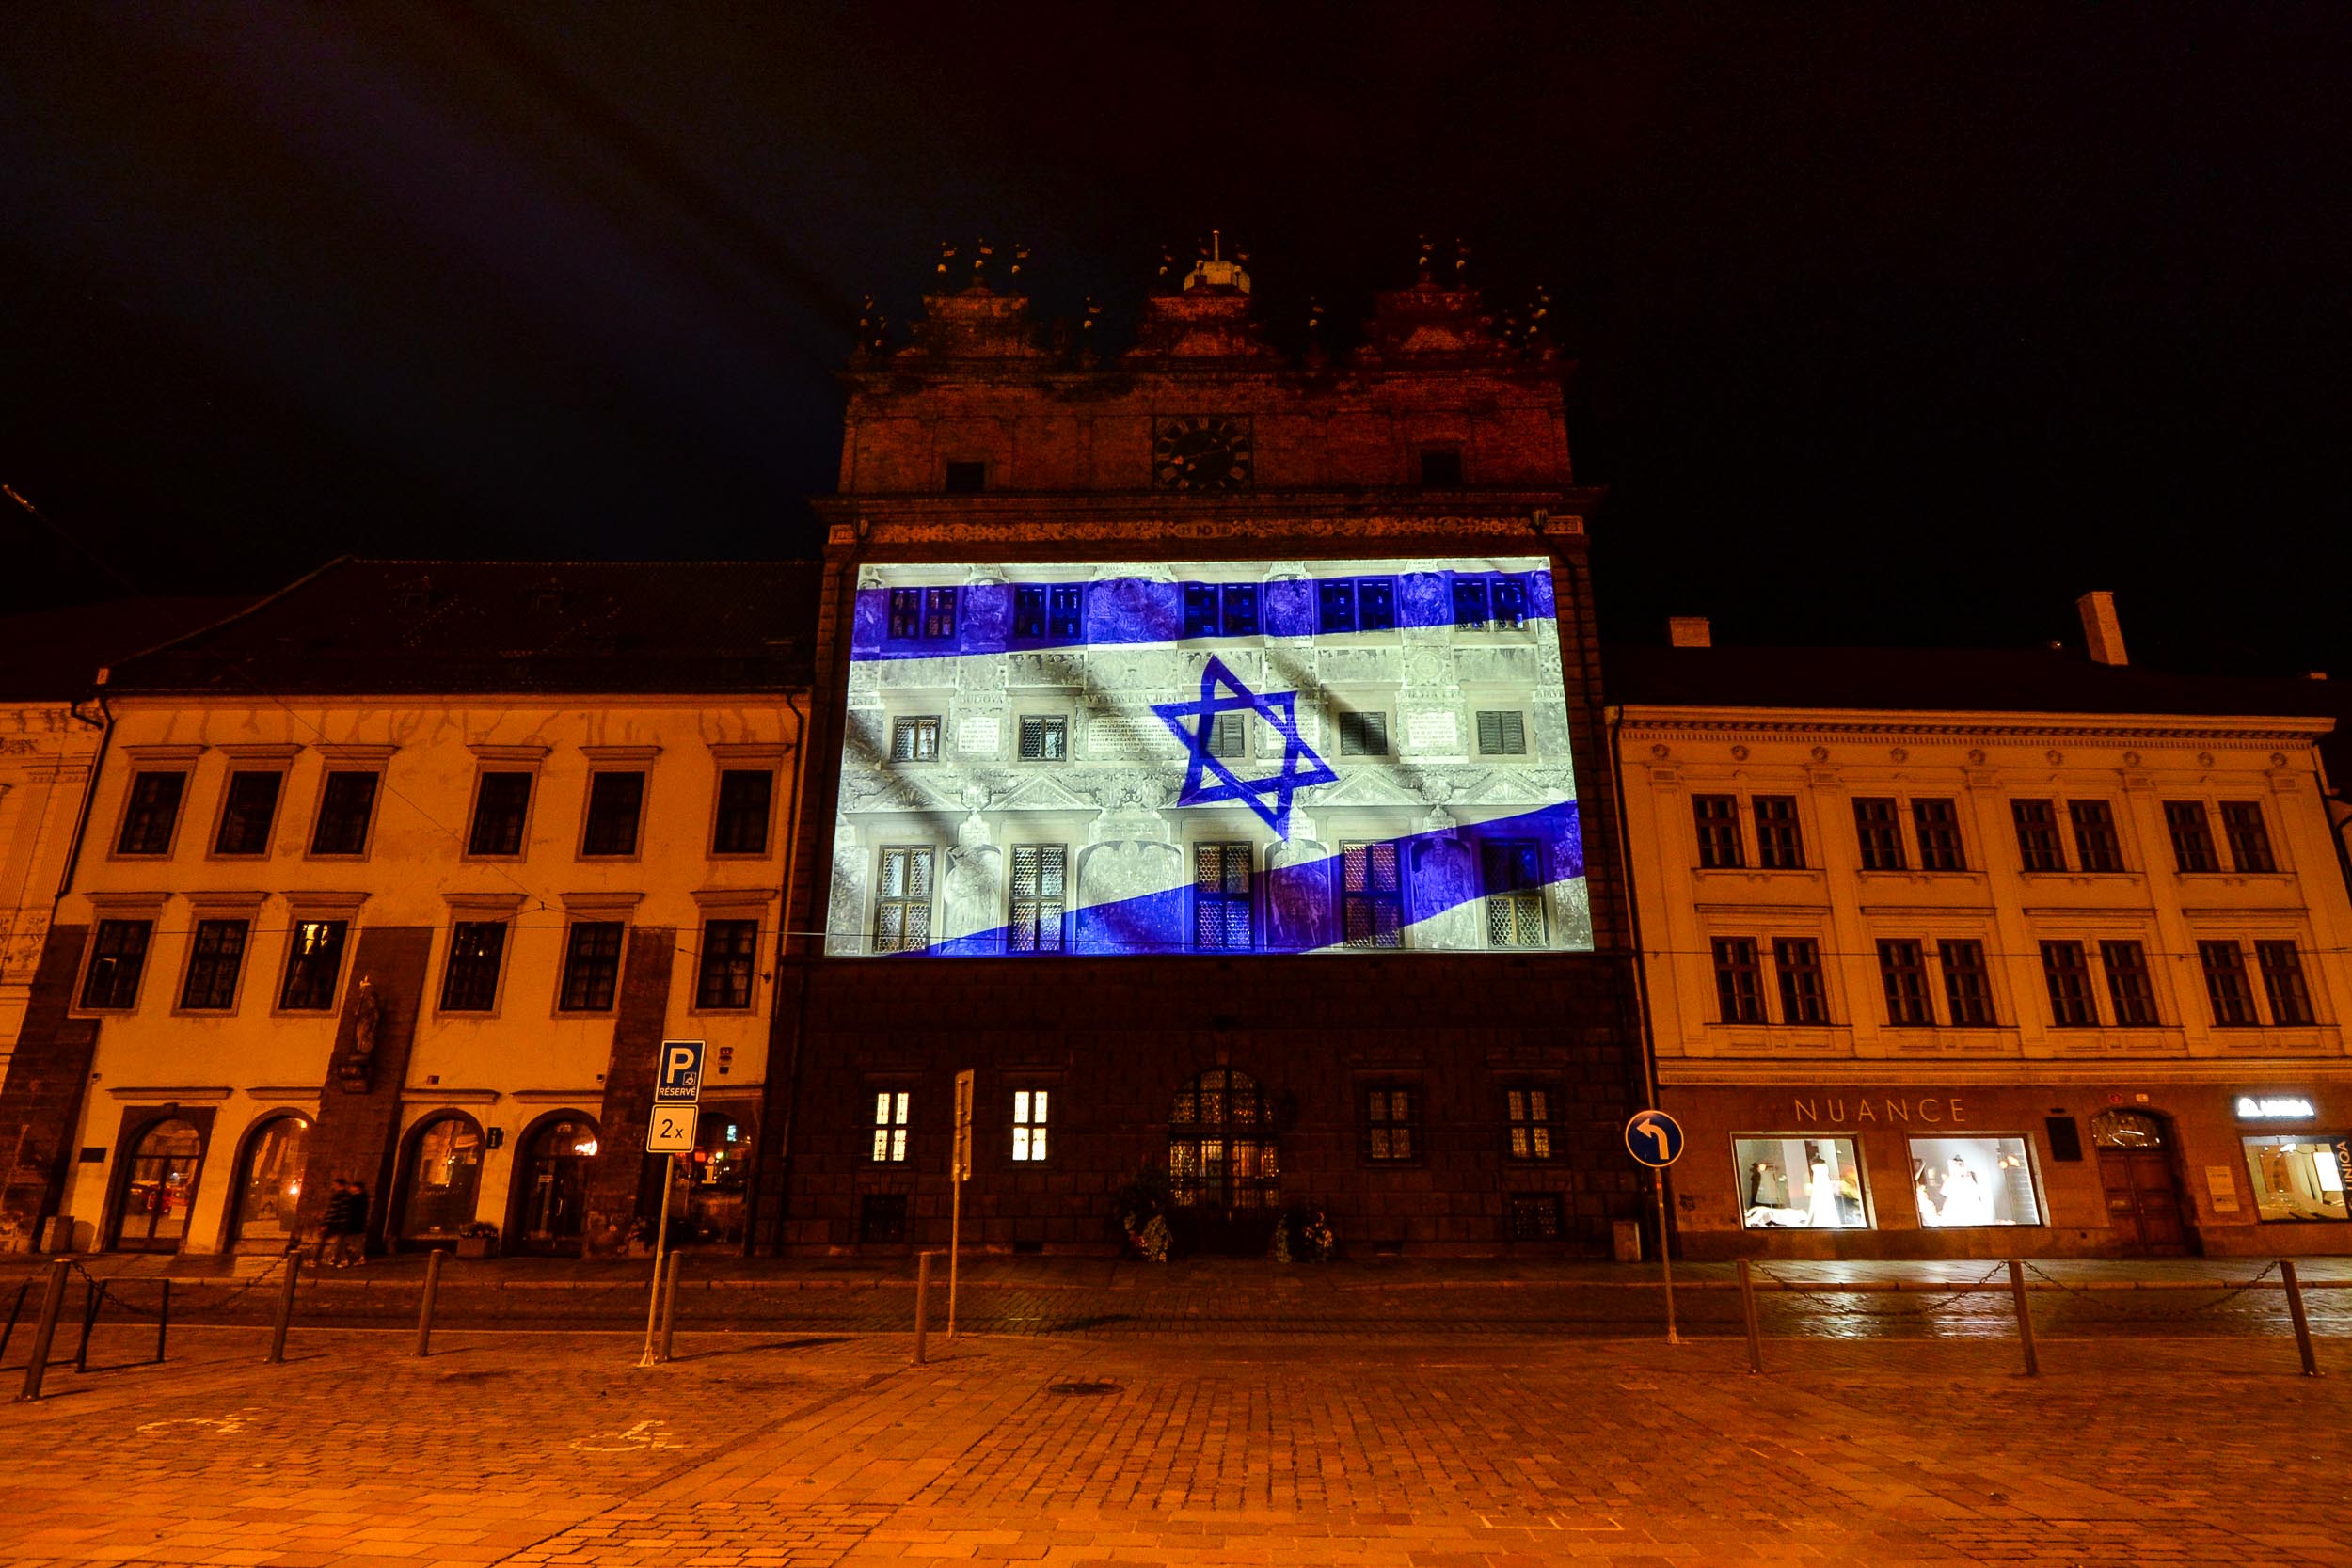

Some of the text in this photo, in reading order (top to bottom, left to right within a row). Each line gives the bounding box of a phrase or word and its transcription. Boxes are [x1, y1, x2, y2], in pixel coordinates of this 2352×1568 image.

[666, 1047, 694, 1084] P
[659, 1085, 696, 1097] RÉSERVÉ
[1794, 1098, 1966, 1122] NUANCE
